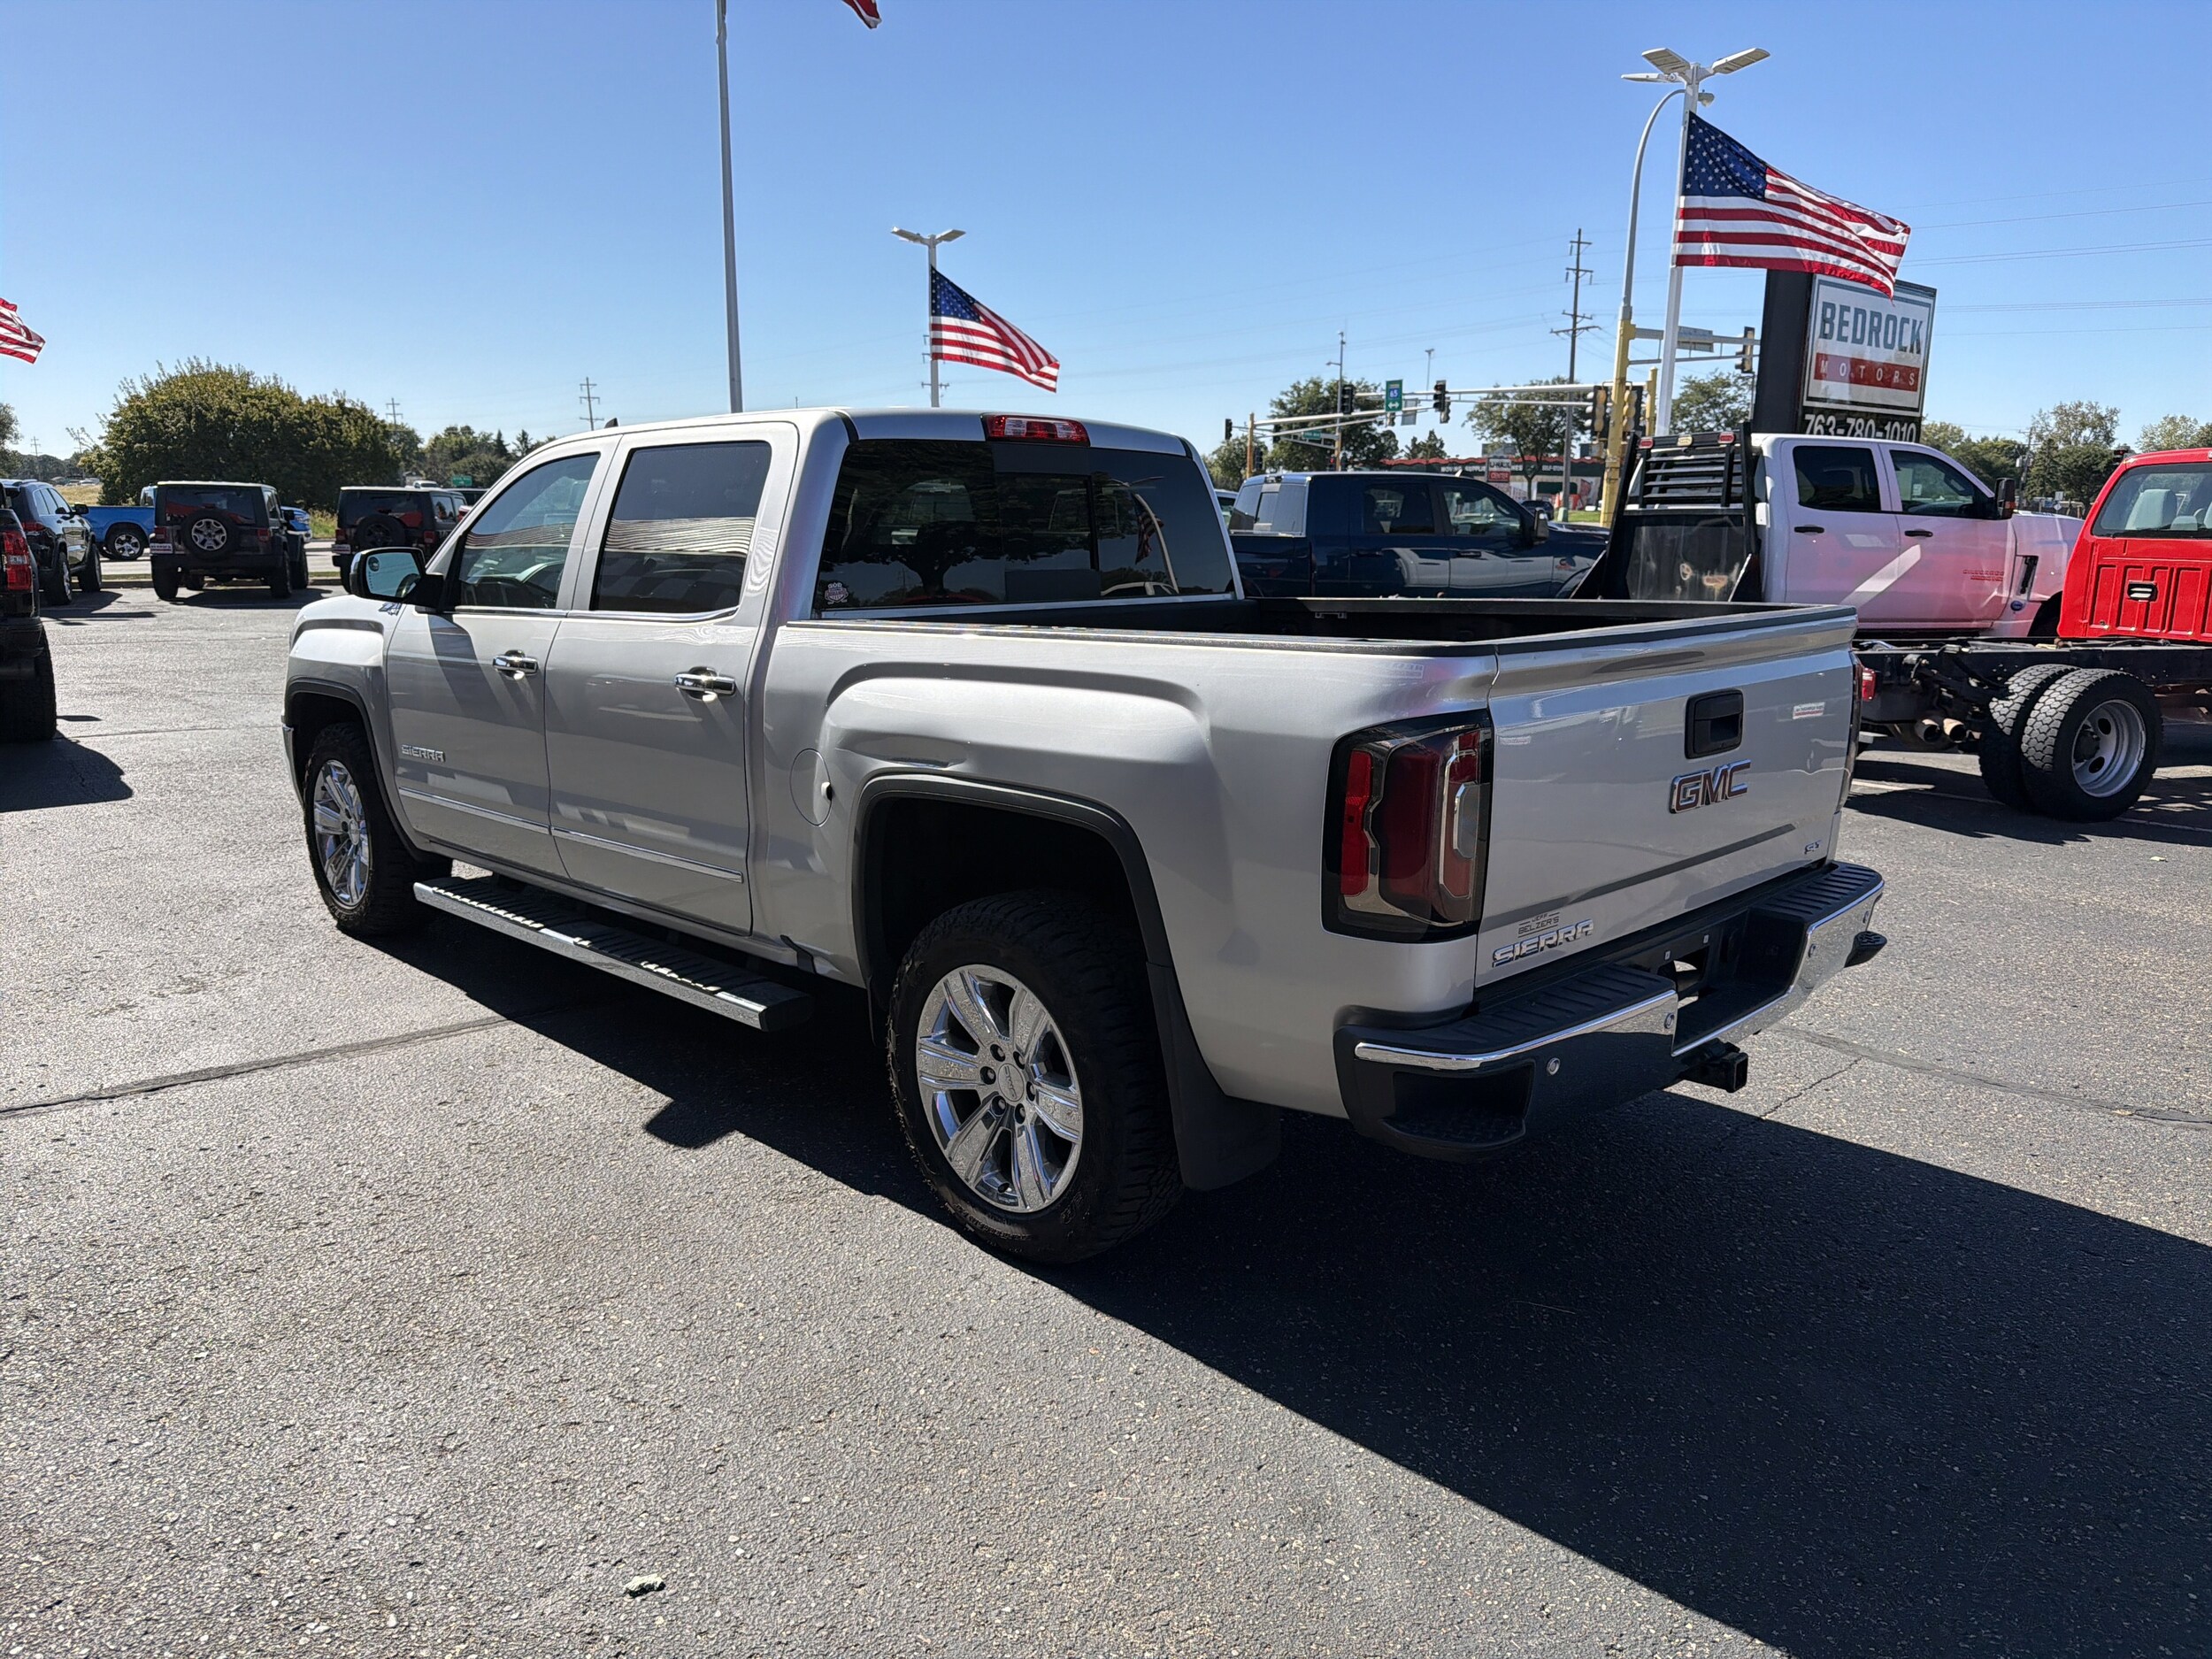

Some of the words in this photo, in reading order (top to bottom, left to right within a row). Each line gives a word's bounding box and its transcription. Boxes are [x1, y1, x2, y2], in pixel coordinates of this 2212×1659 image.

[1818, 301, 1924, 355] BEDROCK
[1820, 364, 1916, 386] MOTORS
[1804, 413, 1917, 442] 763-780-1010
[401, 744, 446, 763] SIERRA
[1670, 759, 1751, 814] GMC
[1491, 918, 1594, 968] SIERRA
